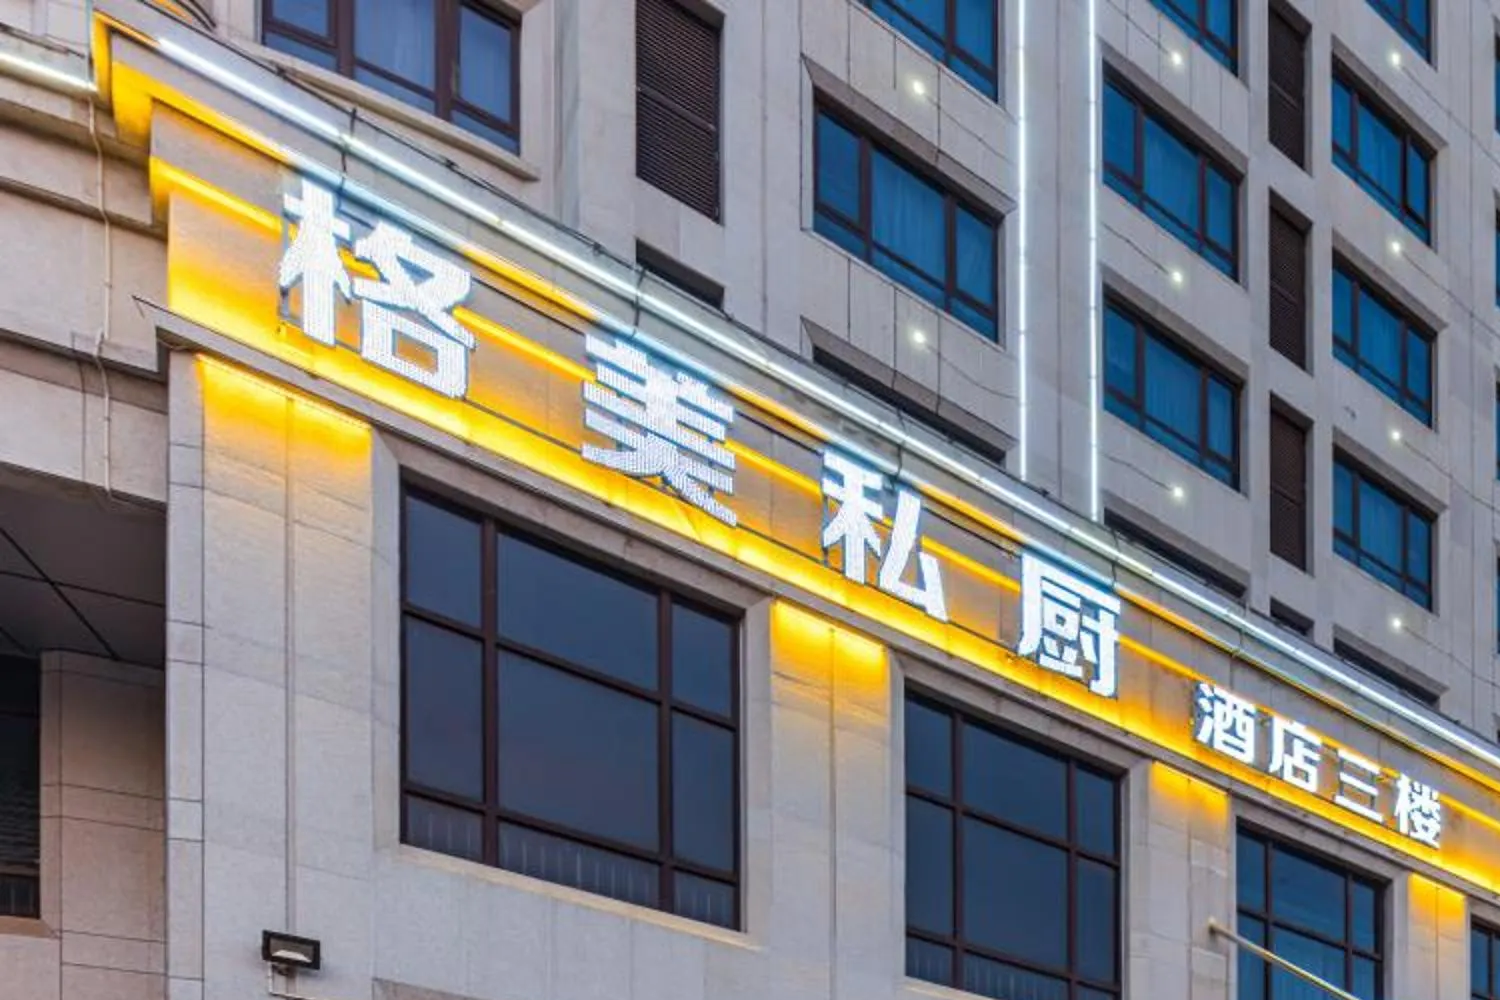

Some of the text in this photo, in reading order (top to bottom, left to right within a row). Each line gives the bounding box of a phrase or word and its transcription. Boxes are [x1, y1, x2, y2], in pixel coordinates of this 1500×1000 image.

[279, 178, 1441, 849] 格美私厨 酒店三楼
